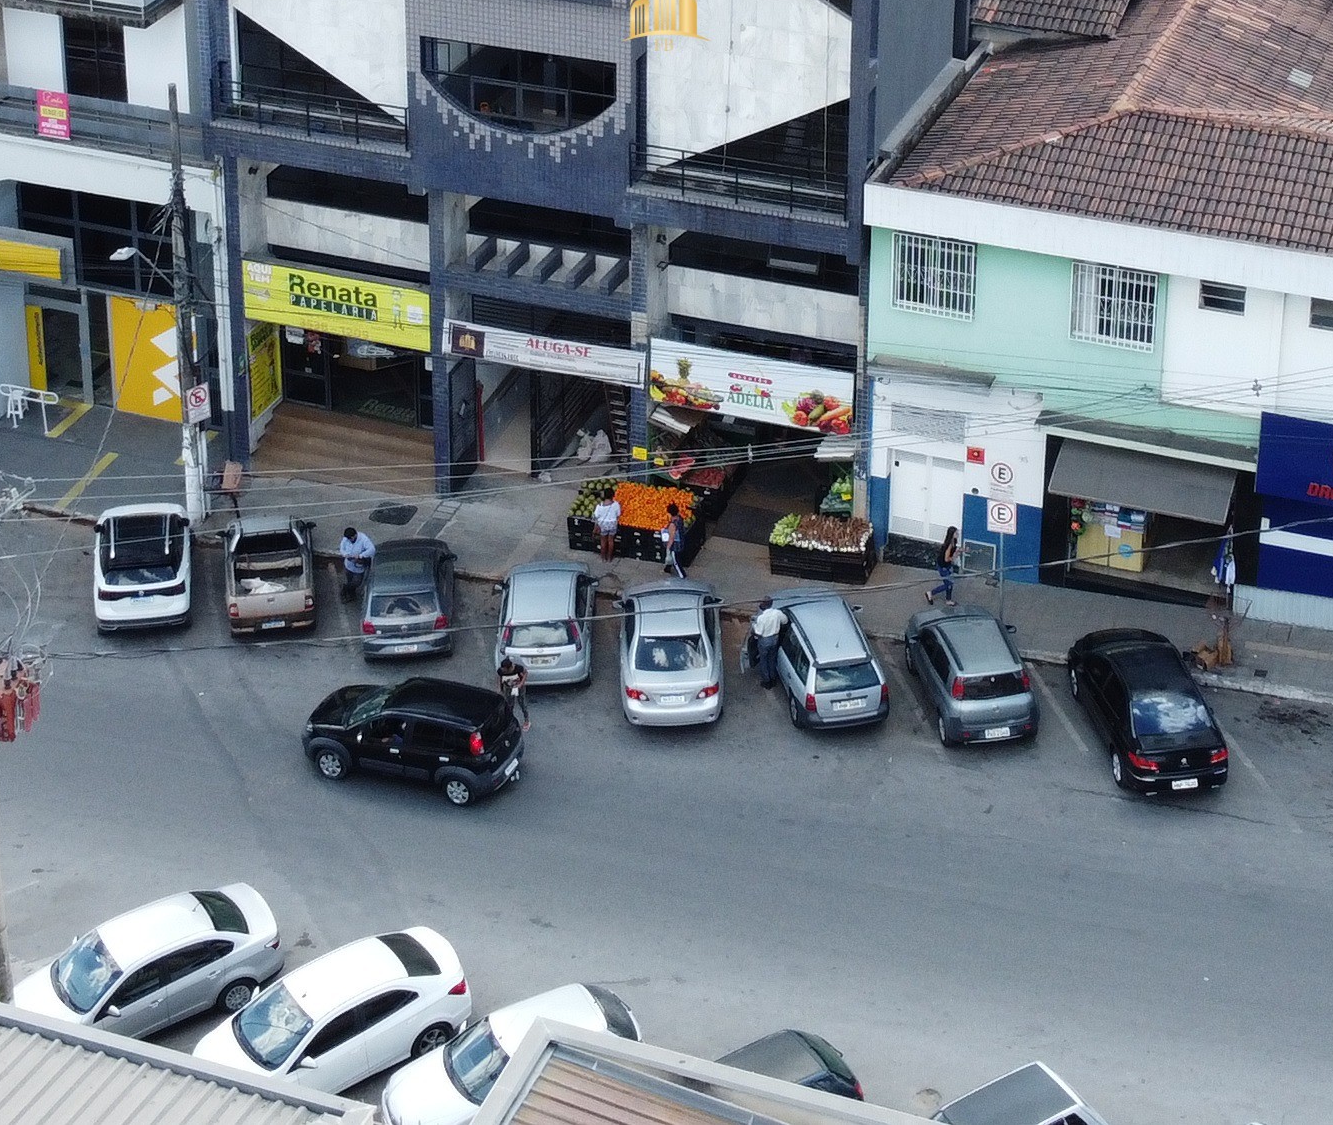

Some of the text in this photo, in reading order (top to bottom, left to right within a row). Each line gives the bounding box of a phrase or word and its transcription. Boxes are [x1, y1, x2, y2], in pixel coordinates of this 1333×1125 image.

[247, 261, 272, 275] AQUI
[288, 273, 377, 308] Renata
[290, 294, 377, 321] PAPELARIA
[525, 337, 592, 358] ALUGA-SE
[727, 390, 775, 411] ADÉLIA
